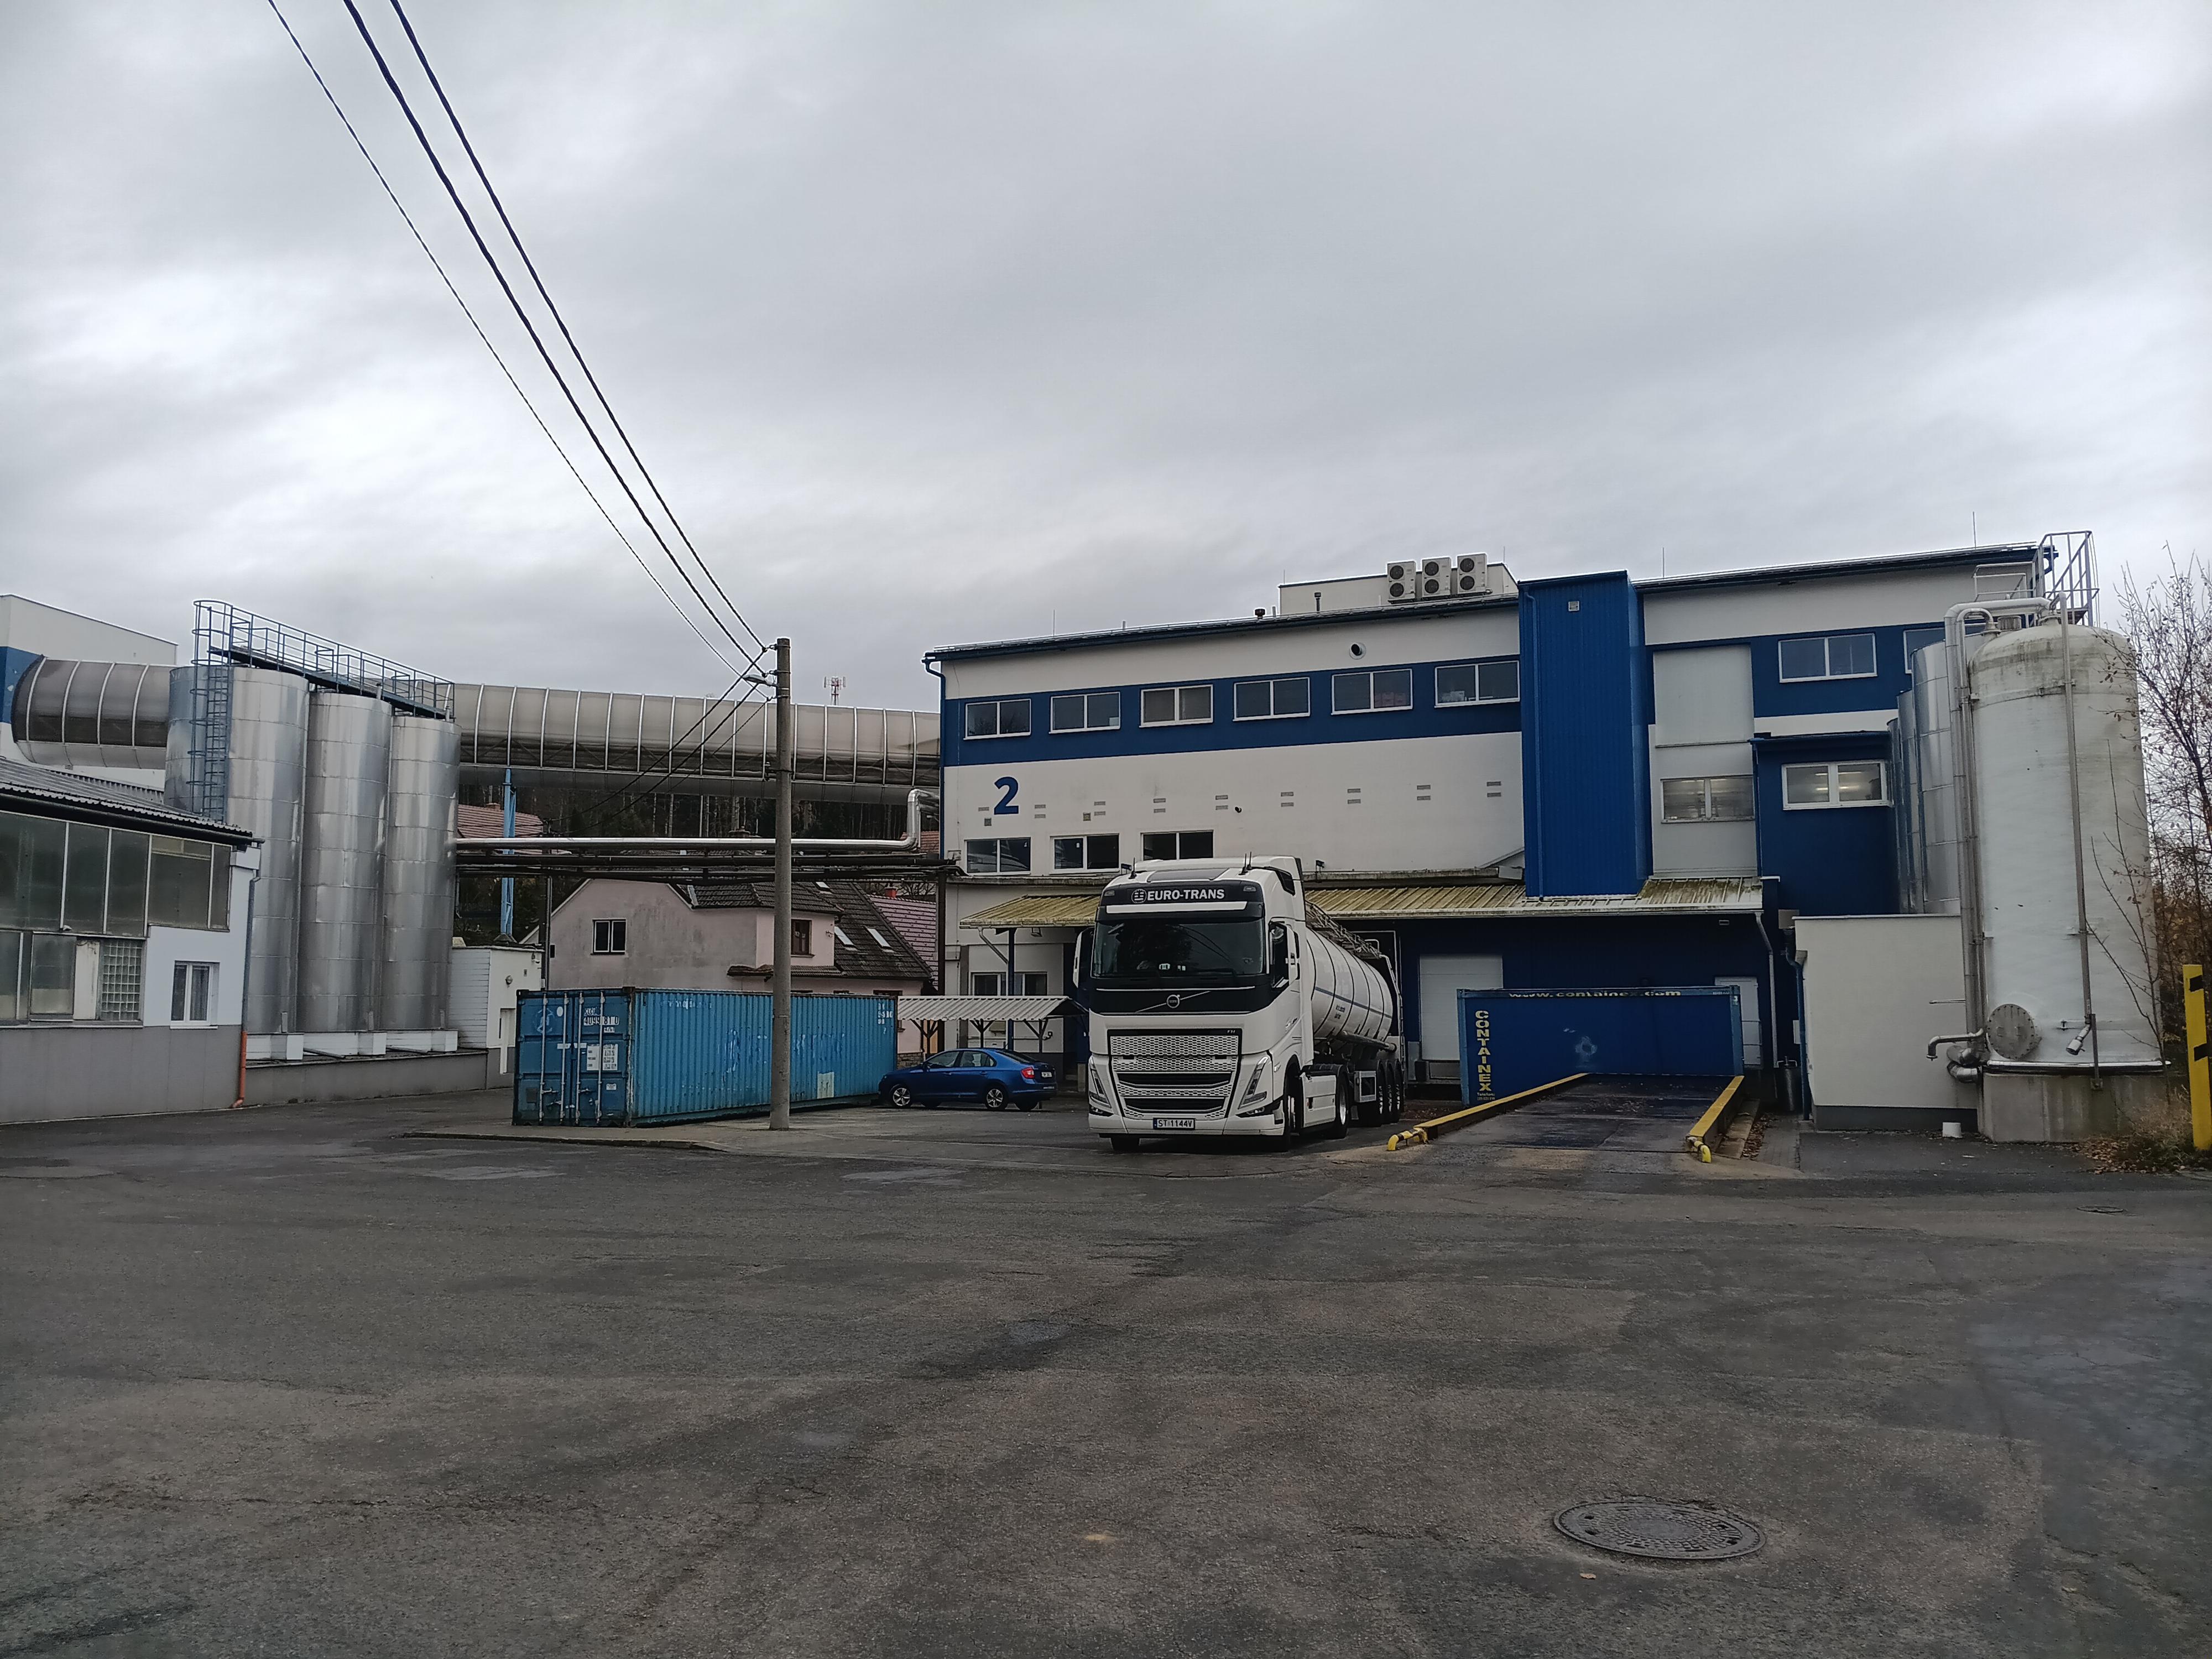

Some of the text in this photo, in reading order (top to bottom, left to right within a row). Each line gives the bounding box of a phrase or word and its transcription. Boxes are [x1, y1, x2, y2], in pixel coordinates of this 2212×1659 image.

[994, 776, 1019, 815] 2
[1147, 889, 1225, 901] EURO-TRANS
[1475, 1010, 1491, 1091] CONTAINEX
